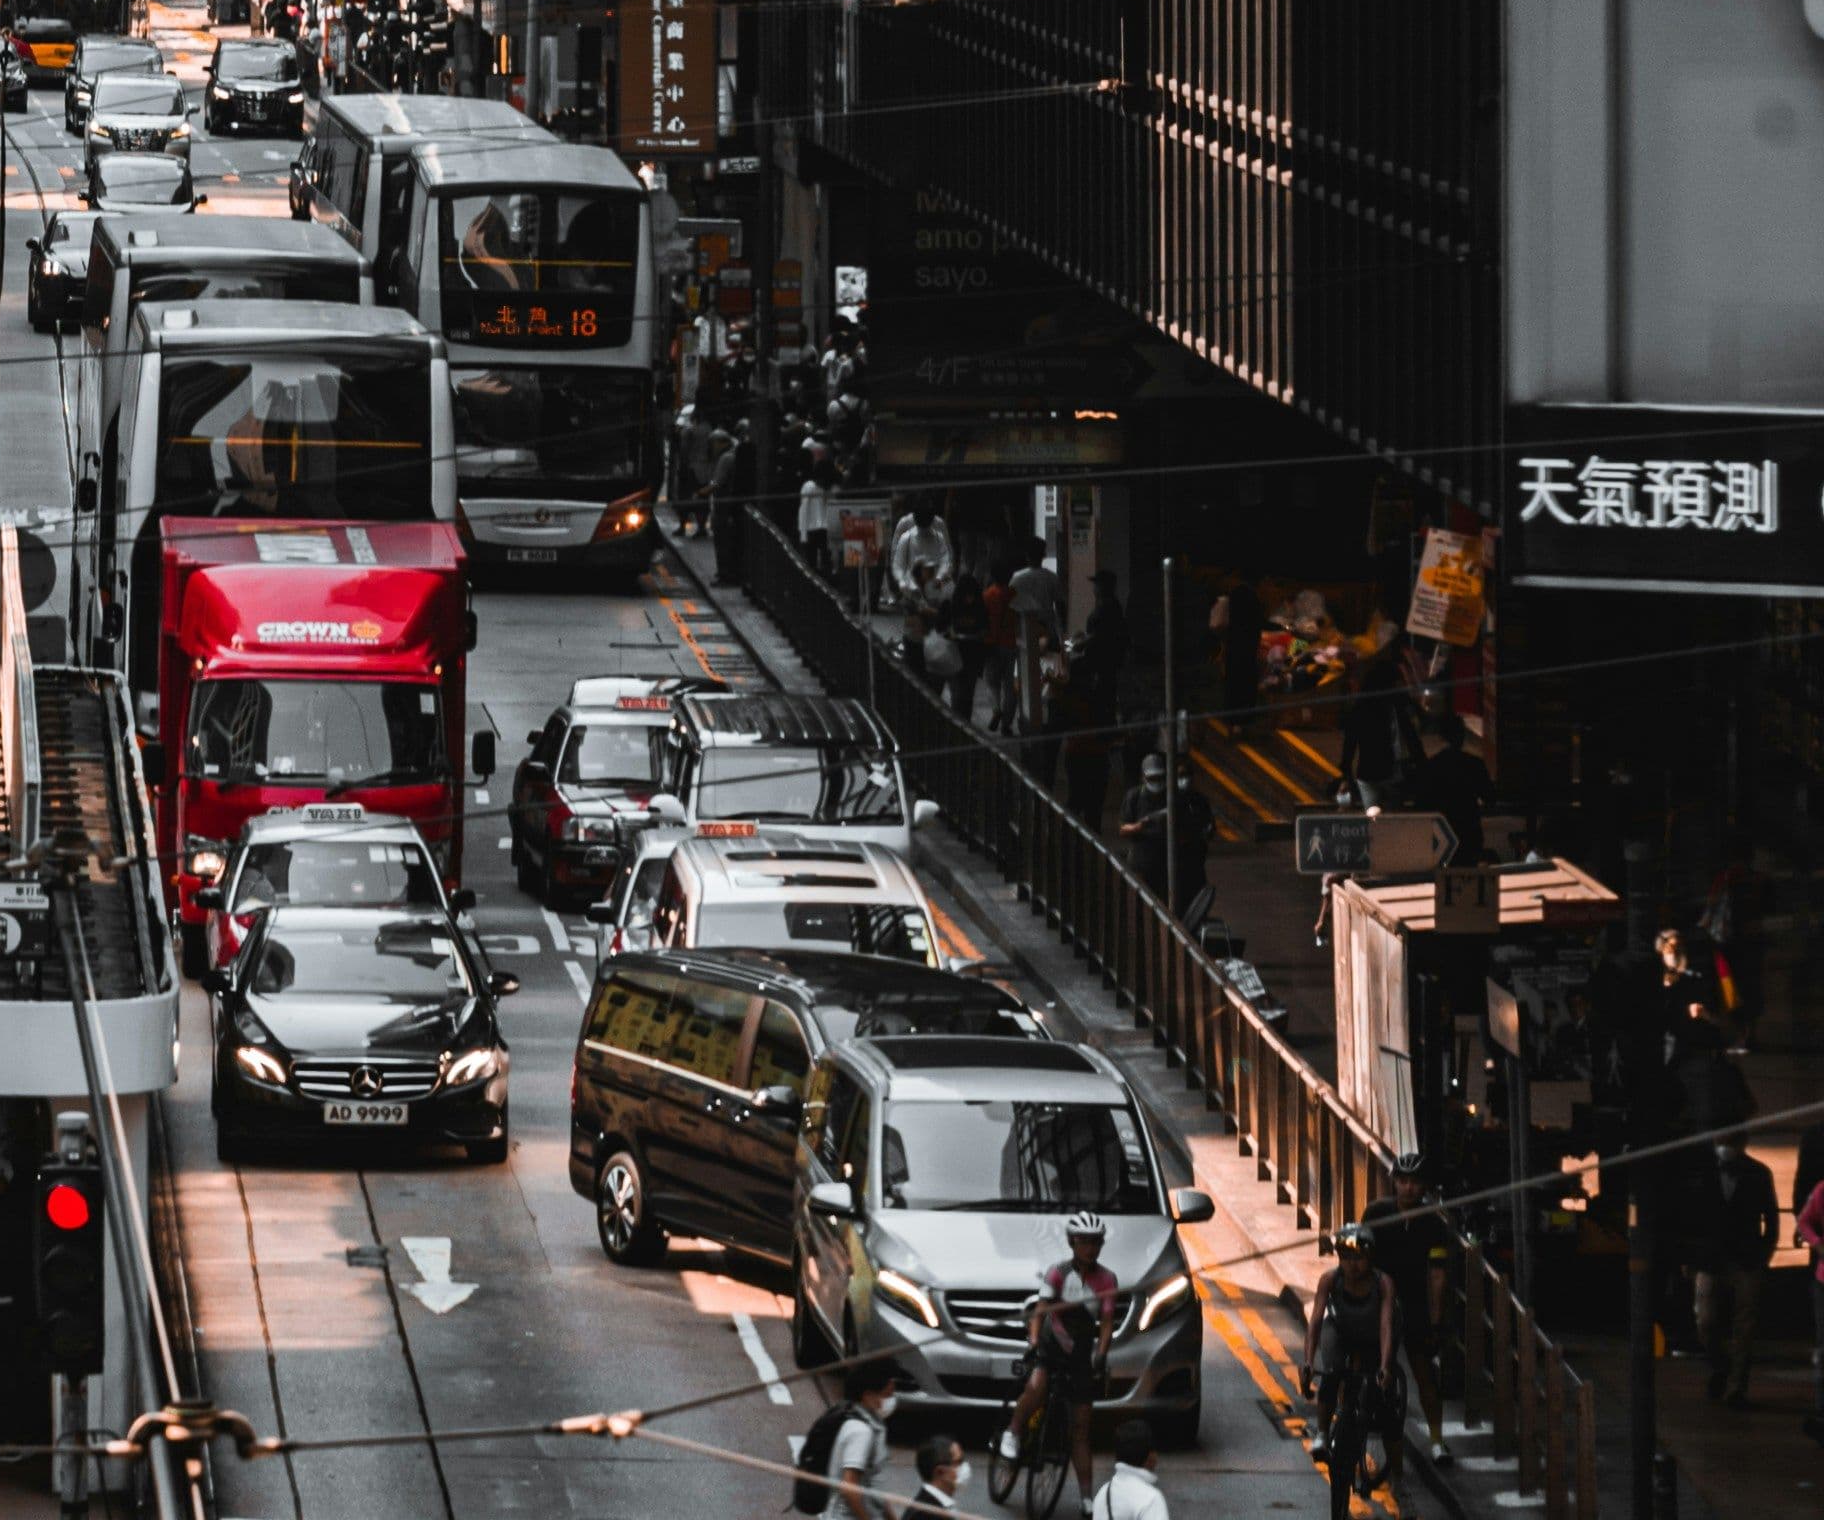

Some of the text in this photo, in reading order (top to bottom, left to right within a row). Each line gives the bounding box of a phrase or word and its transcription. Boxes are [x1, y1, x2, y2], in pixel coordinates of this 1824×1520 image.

[572, 309, 597, 336] 18
[1518, 456, 1779, 533] 天氣預測
[257, 621, 349, 637] CROWN
[618, 695, 668, 709] TAXI
[307, 808, 362, 820] TAXI
[699, 823, 756, 836] TAXI
[329, 1105, 404, 1122] AD 9999
